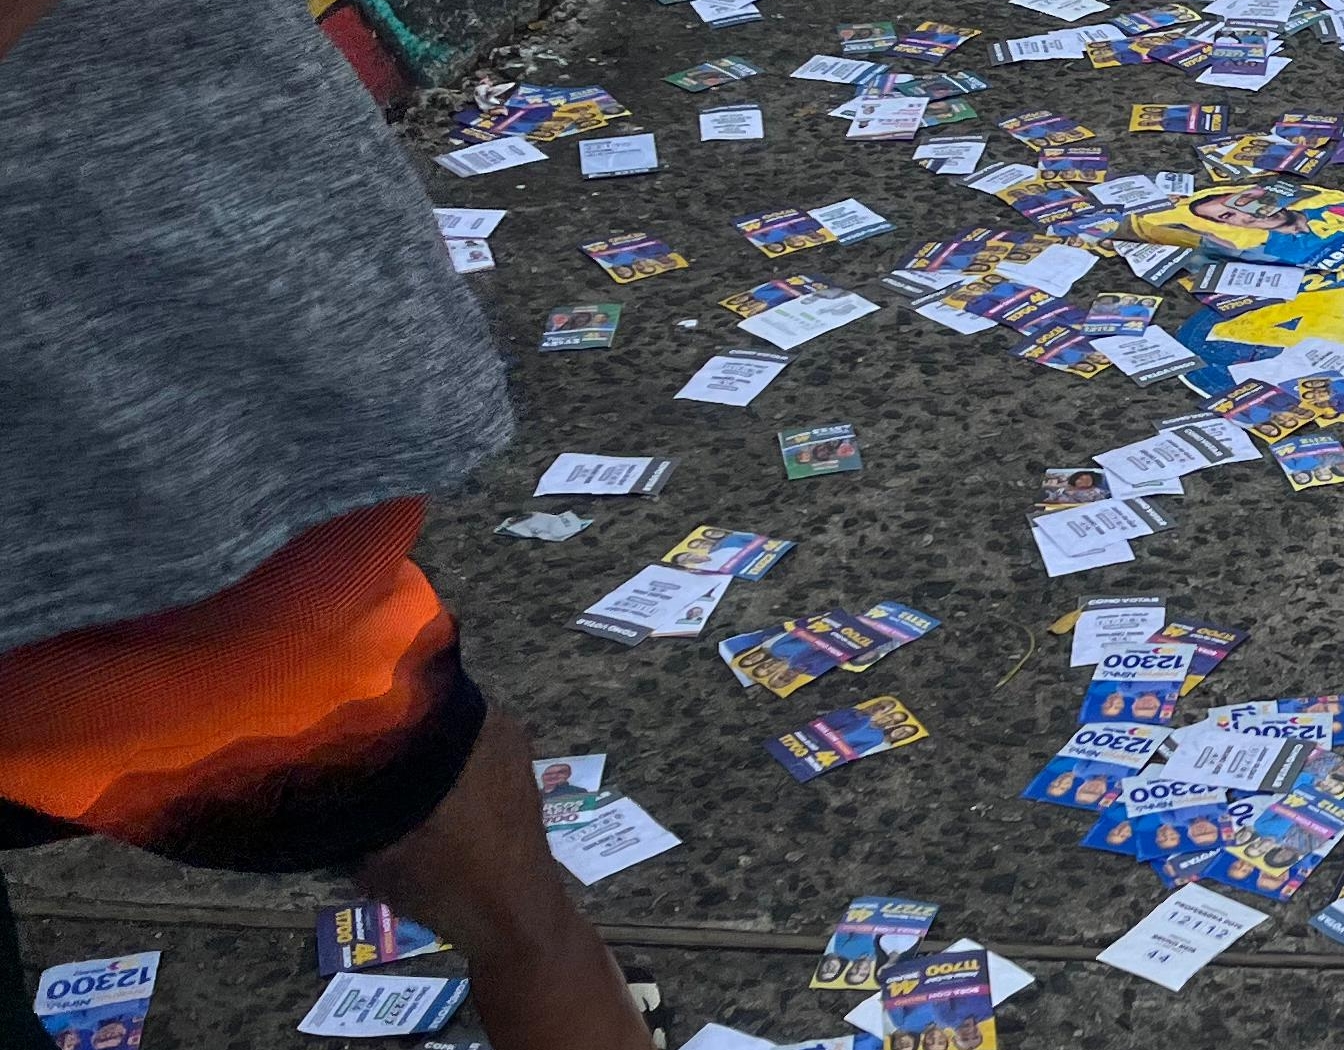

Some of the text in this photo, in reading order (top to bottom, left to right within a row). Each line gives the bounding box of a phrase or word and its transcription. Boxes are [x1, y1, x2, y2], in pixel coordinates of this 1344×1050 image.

[1103, 653, 1184, 669] 12300
[1075, 731, 1154, 753] 12300
[925, 960, 980, 977] 11700
[46, 965, 152, 1000] 12300
